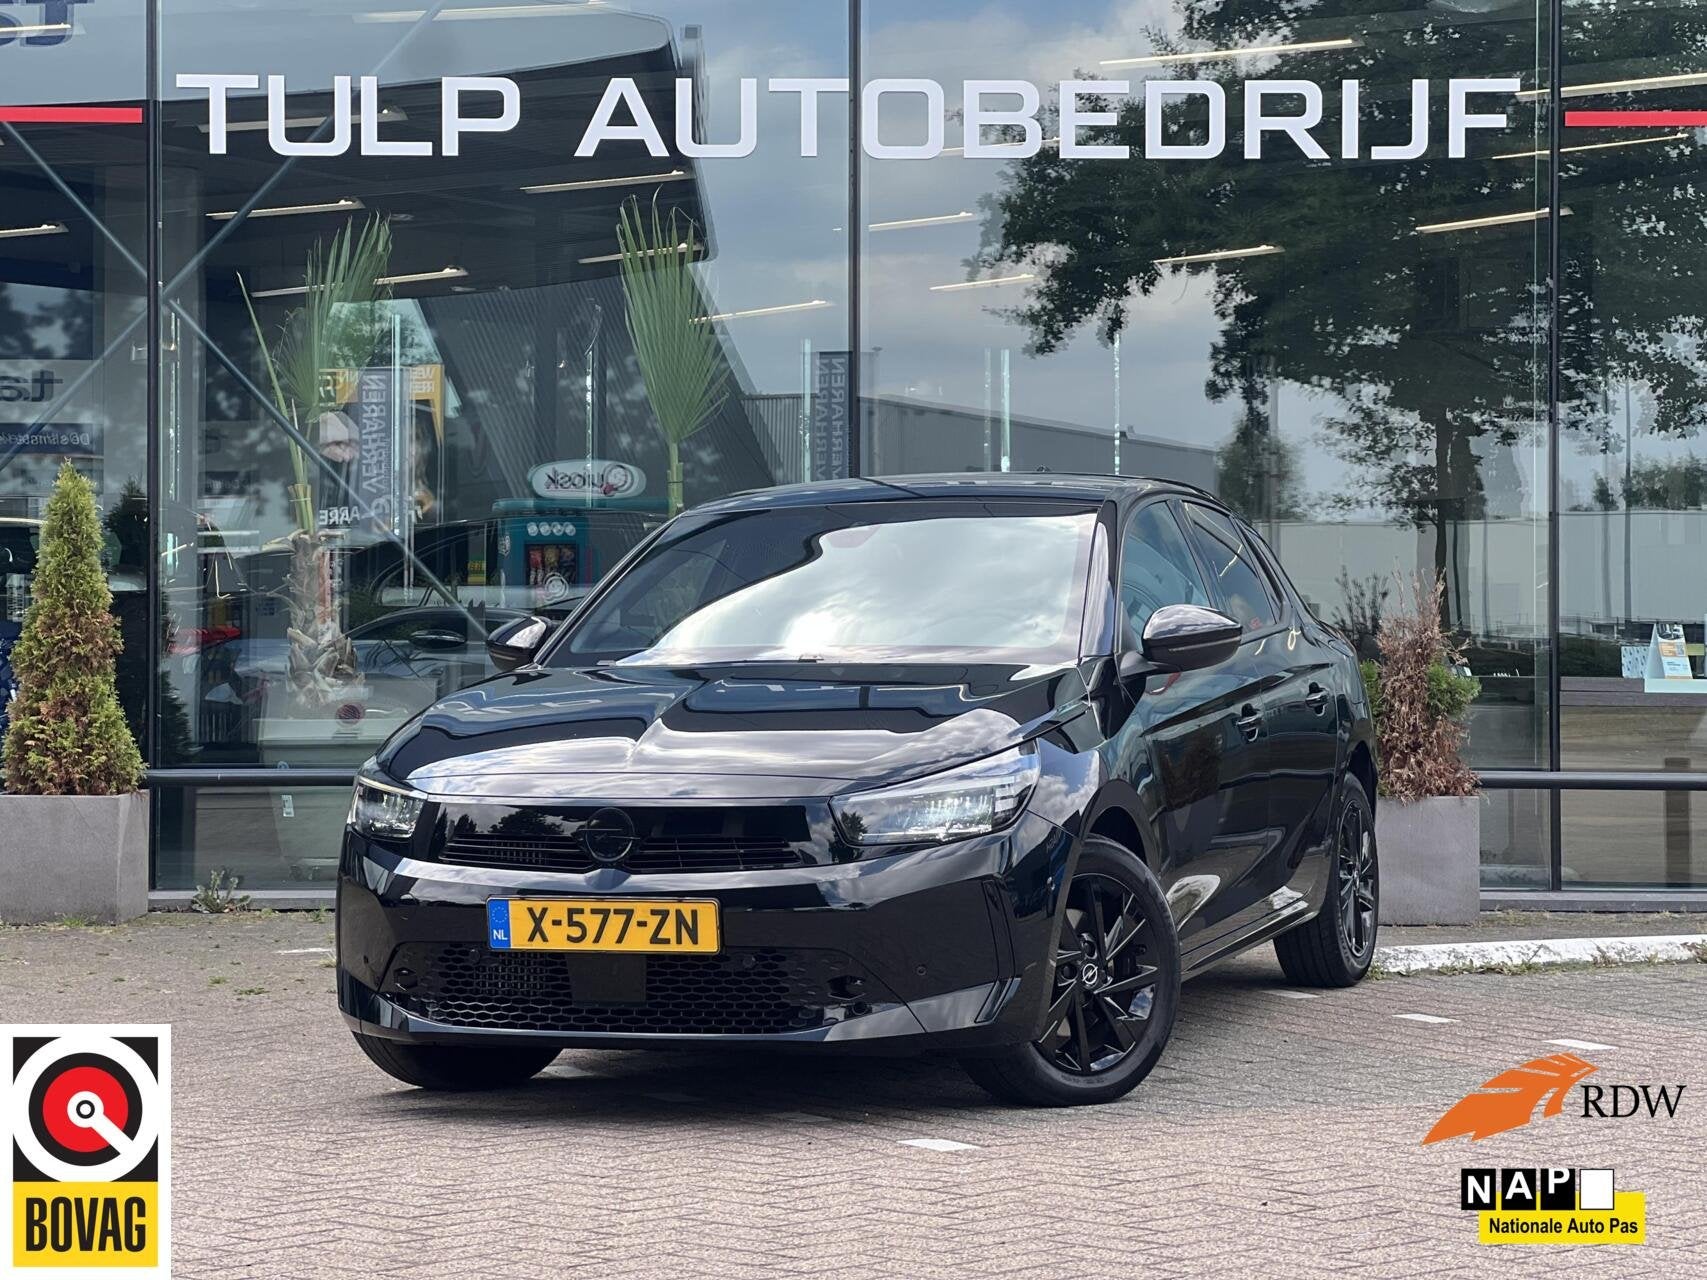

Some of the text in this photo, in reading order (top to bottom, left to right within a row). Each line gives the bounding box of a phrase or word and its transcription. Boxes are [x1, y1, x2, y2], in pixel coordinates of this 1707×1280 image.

[175, 73, 1521, 161] TULP AUTOBEDRIJF
[493, 929, 508, 941] NL
[526, 906, 699, 946] X-577-ZN
